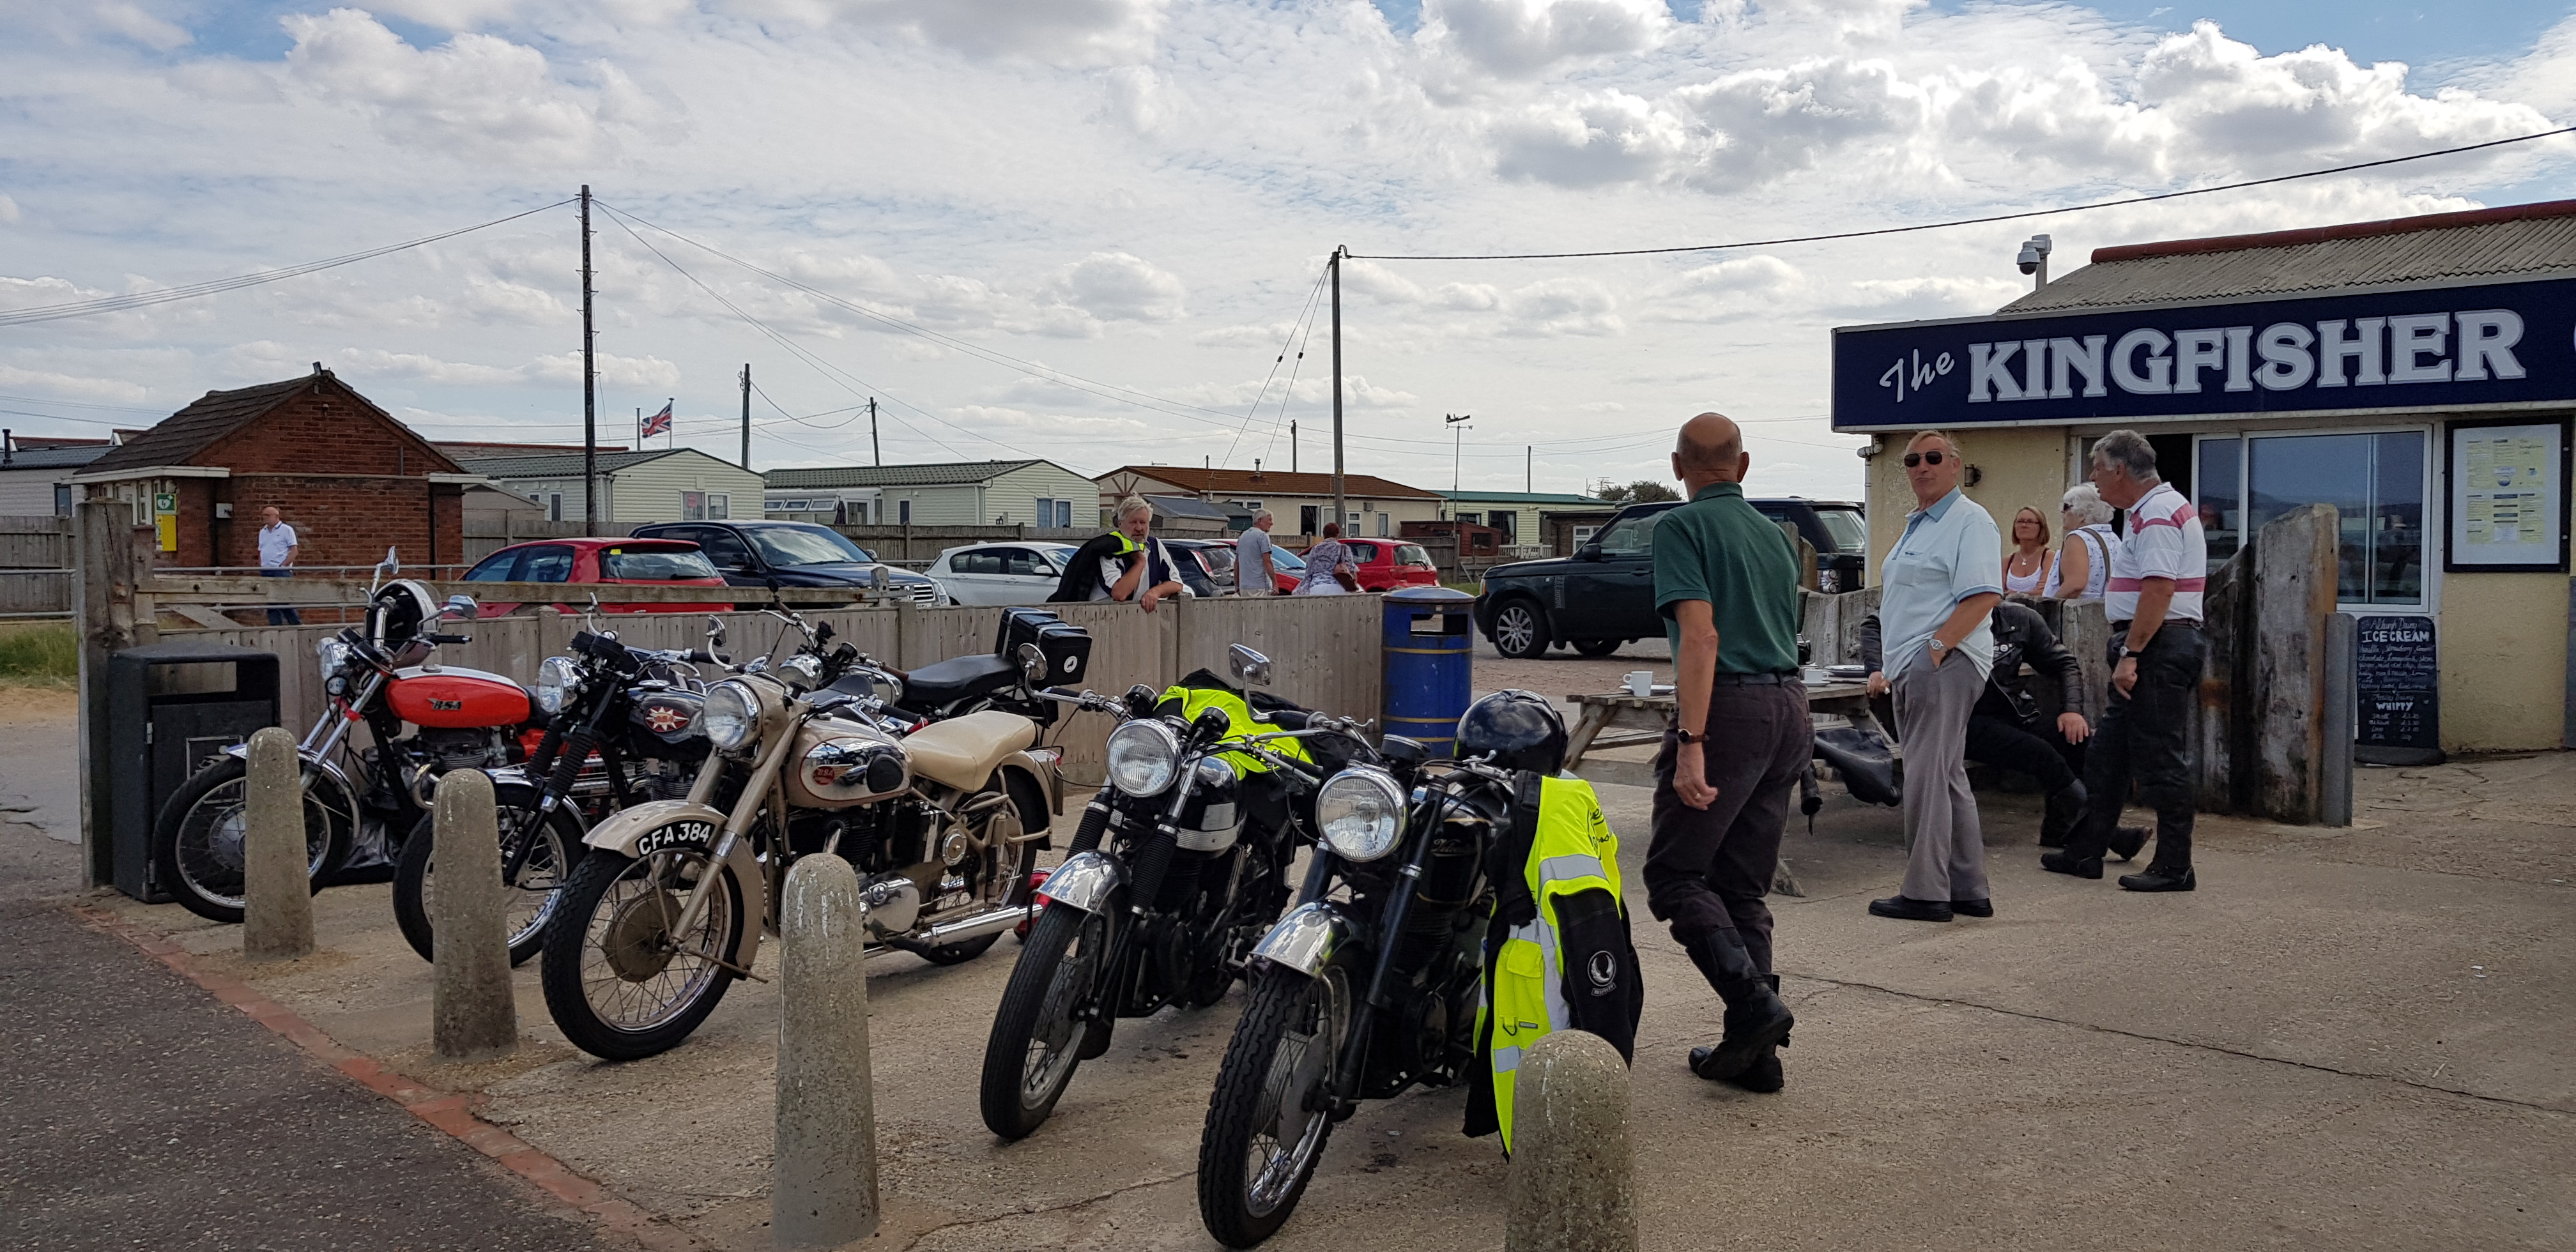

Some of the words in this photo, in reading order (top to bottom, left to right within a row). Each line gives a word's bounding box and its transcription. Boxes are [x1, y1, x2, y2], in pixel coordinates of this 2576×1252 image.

[1879, 348, 1955, 402] The
[1967, 309, 2527, 404] KINGFISHER
[2389, 630, 2430, 642] CREAM
[2375, 702, 2414, 712] WHIPPY
[639, 826, 674, 855] CFA
[678, 823, 710, 843] 384
